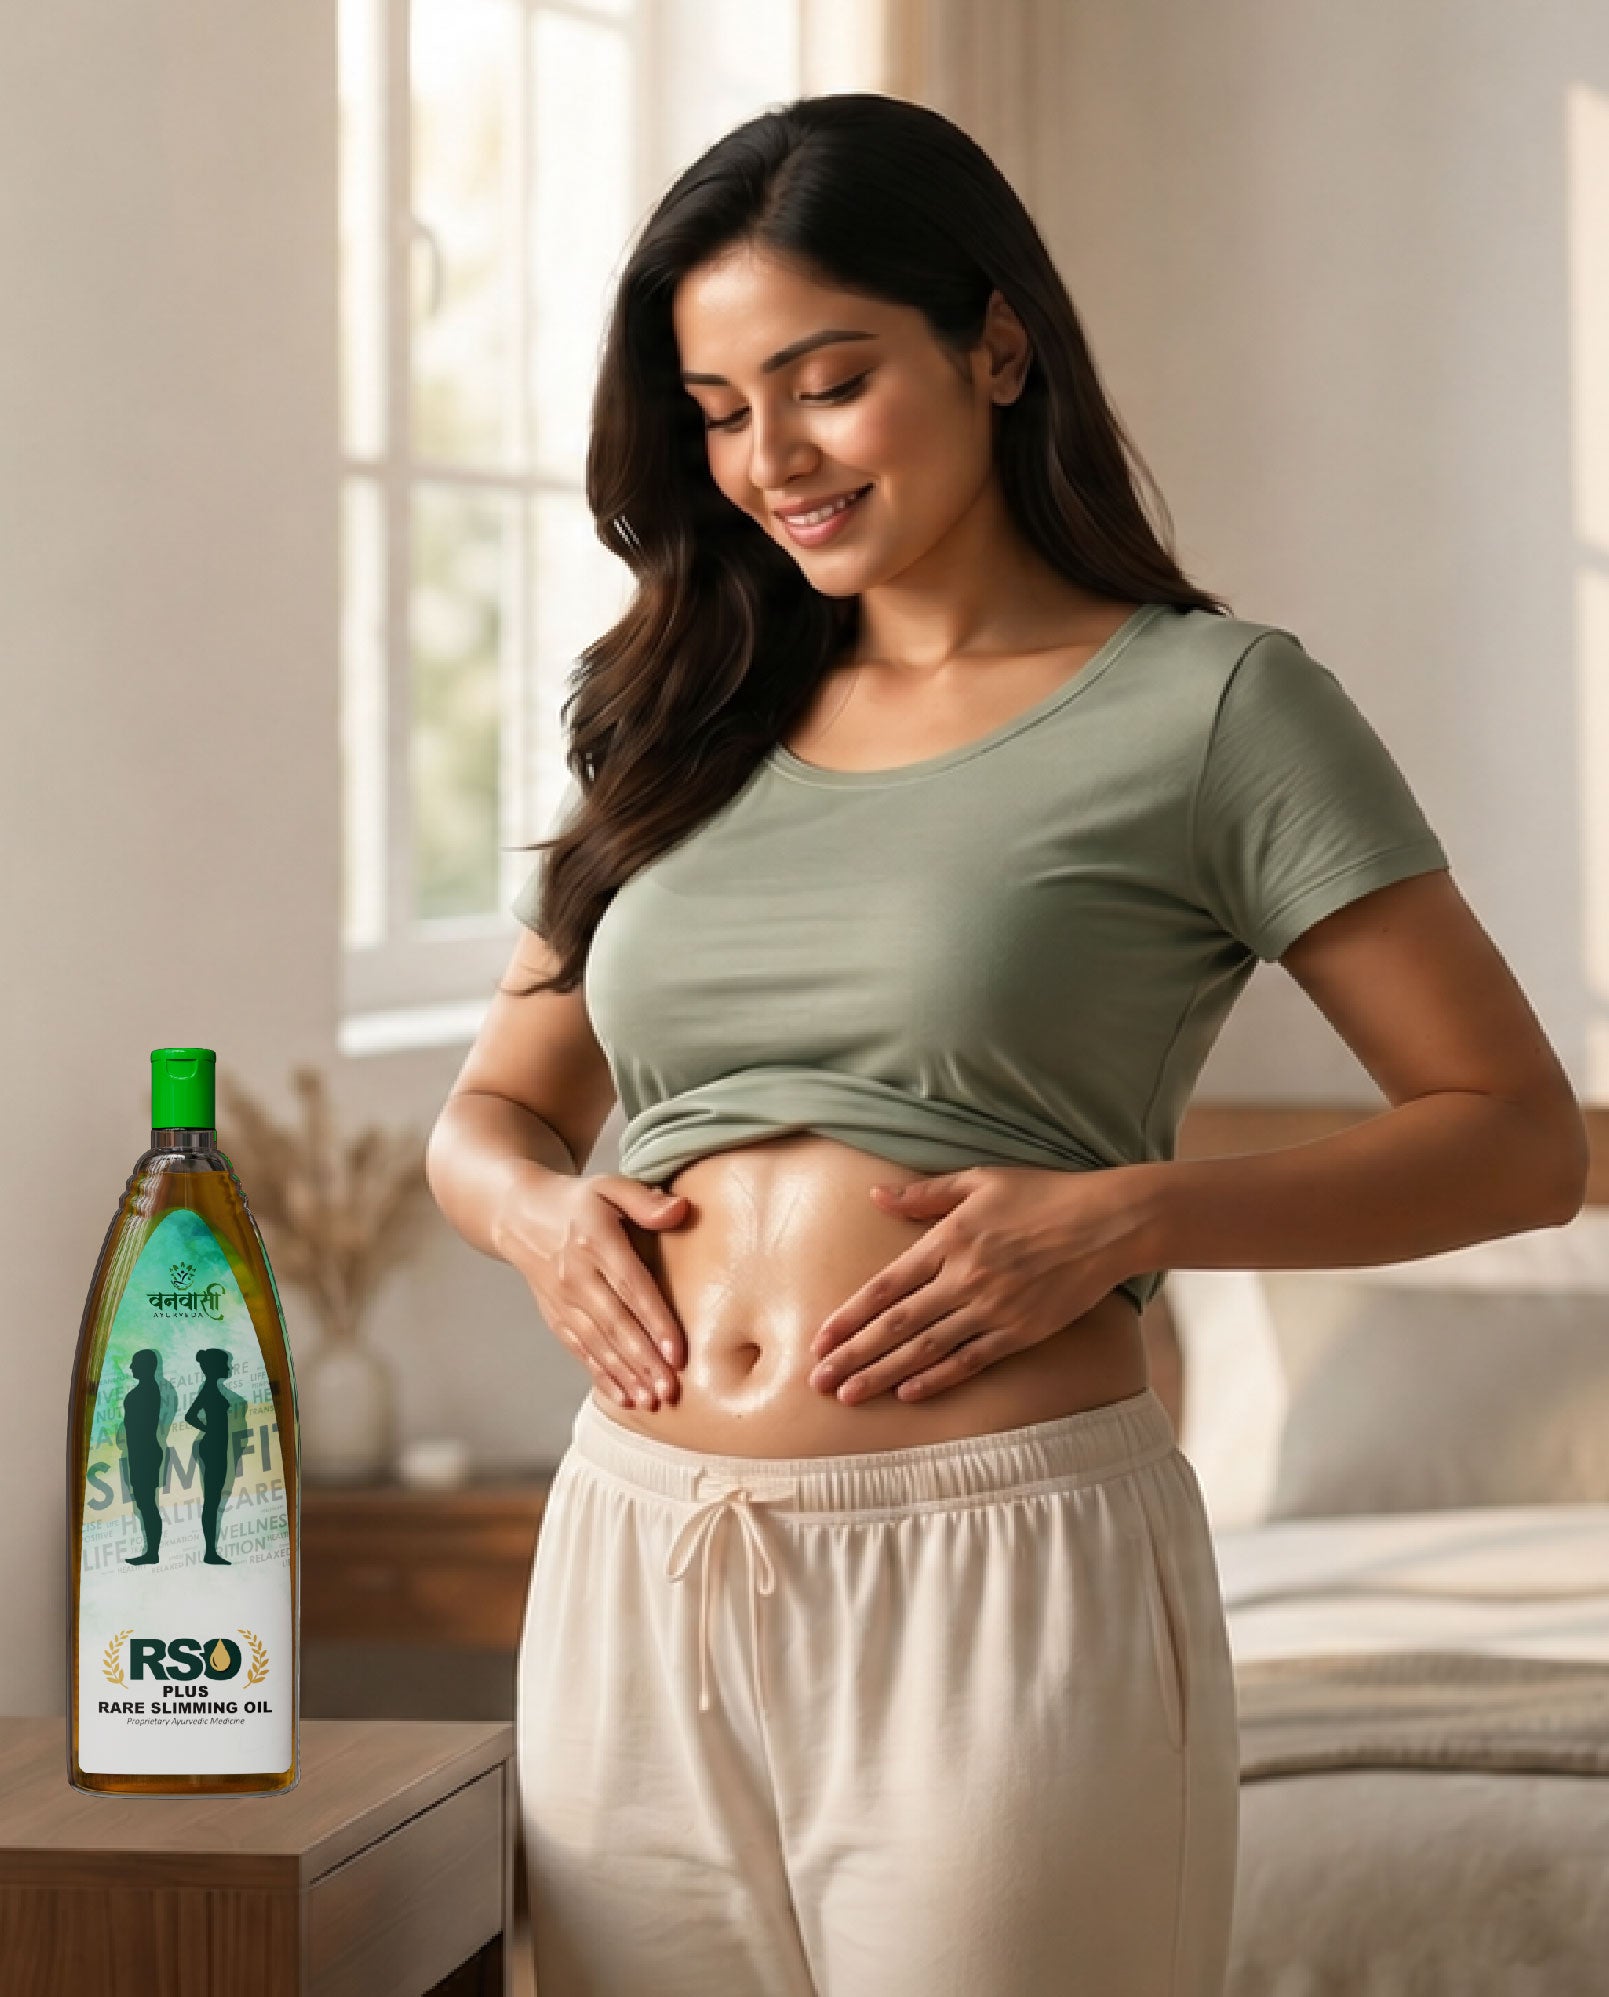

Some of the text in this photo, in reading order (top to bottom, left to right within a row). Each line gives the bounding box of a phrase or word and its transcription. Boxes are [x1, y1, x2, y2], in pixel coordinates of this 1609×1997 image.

[146, 1282, 226, 1321] वनवासी
[220, 1513, 287, 1542] WELLNES
[130, 1638, 242, 1681] RSO
[163, 1685, 209, 1698] PLUS
[98, 1701, 273, 1714] RARE SLIMMING OIL
[127, 1717, 246, 1726] Proprietary Ayurvedic Medicine
